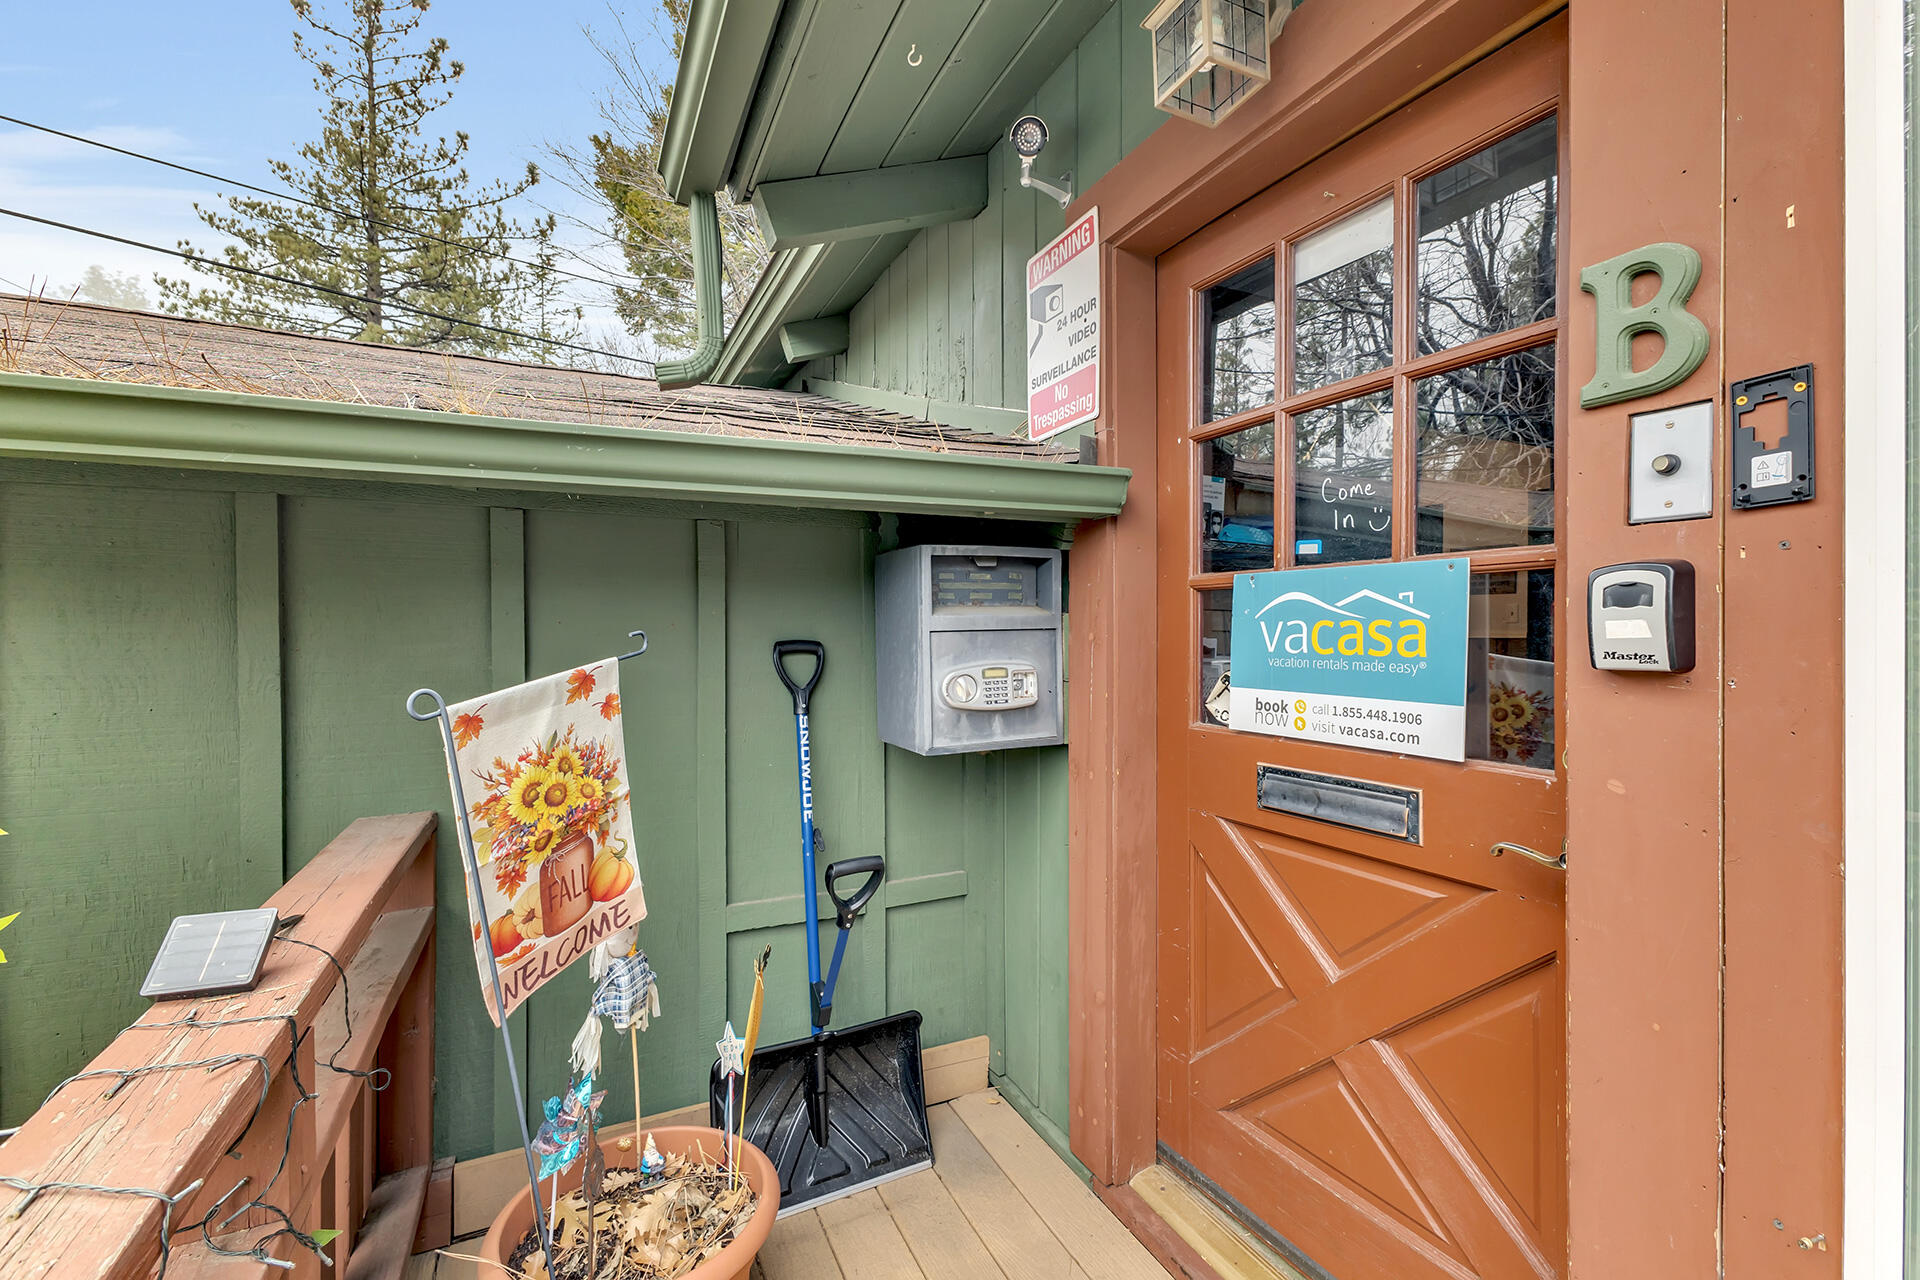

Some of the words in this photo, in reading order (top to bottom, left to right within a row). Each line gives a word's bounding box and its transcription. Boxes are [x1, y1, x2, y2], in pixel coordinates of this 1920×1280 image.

[1031, 223, 1091, 282] WARNING
[1056, 318, 1068, 332] 24
[1070, 297, 1097, 321] HOUR
[1581, 242, 1711, 408] B
[1068, 321, 1097, 348] VIDEO
[1031, 345, 1096, 390] SURVEILLANCE
[1054, 382, 1068, 404] No
[1033, 392, 1093, 432] Trespassing
[1321, 477, 1376, 503] Come
[1333, 508, 1355, 531] In
[1259, 619, 1427, 658] vacasa
[1268, 656, 1310, 669] vacation
[1312, 657, 1349, 671] rentals
[1352, 659, 1386, 673] made
[1602, 651, 1655, 660] Master
[1254, 711, 1289, 727] now
[1255, 698, 1289, 714] book
[1312, 703, 1330, 716] call
[1332, 704, 1423, 726] 1.855.448.1906
[1311, 720, 1336, 735] visit
[1338, 724, 1421, 745] vacasa.com
[549, 863, 589, 912] FALL
[502, 899, 631, 1009] WELCOME
